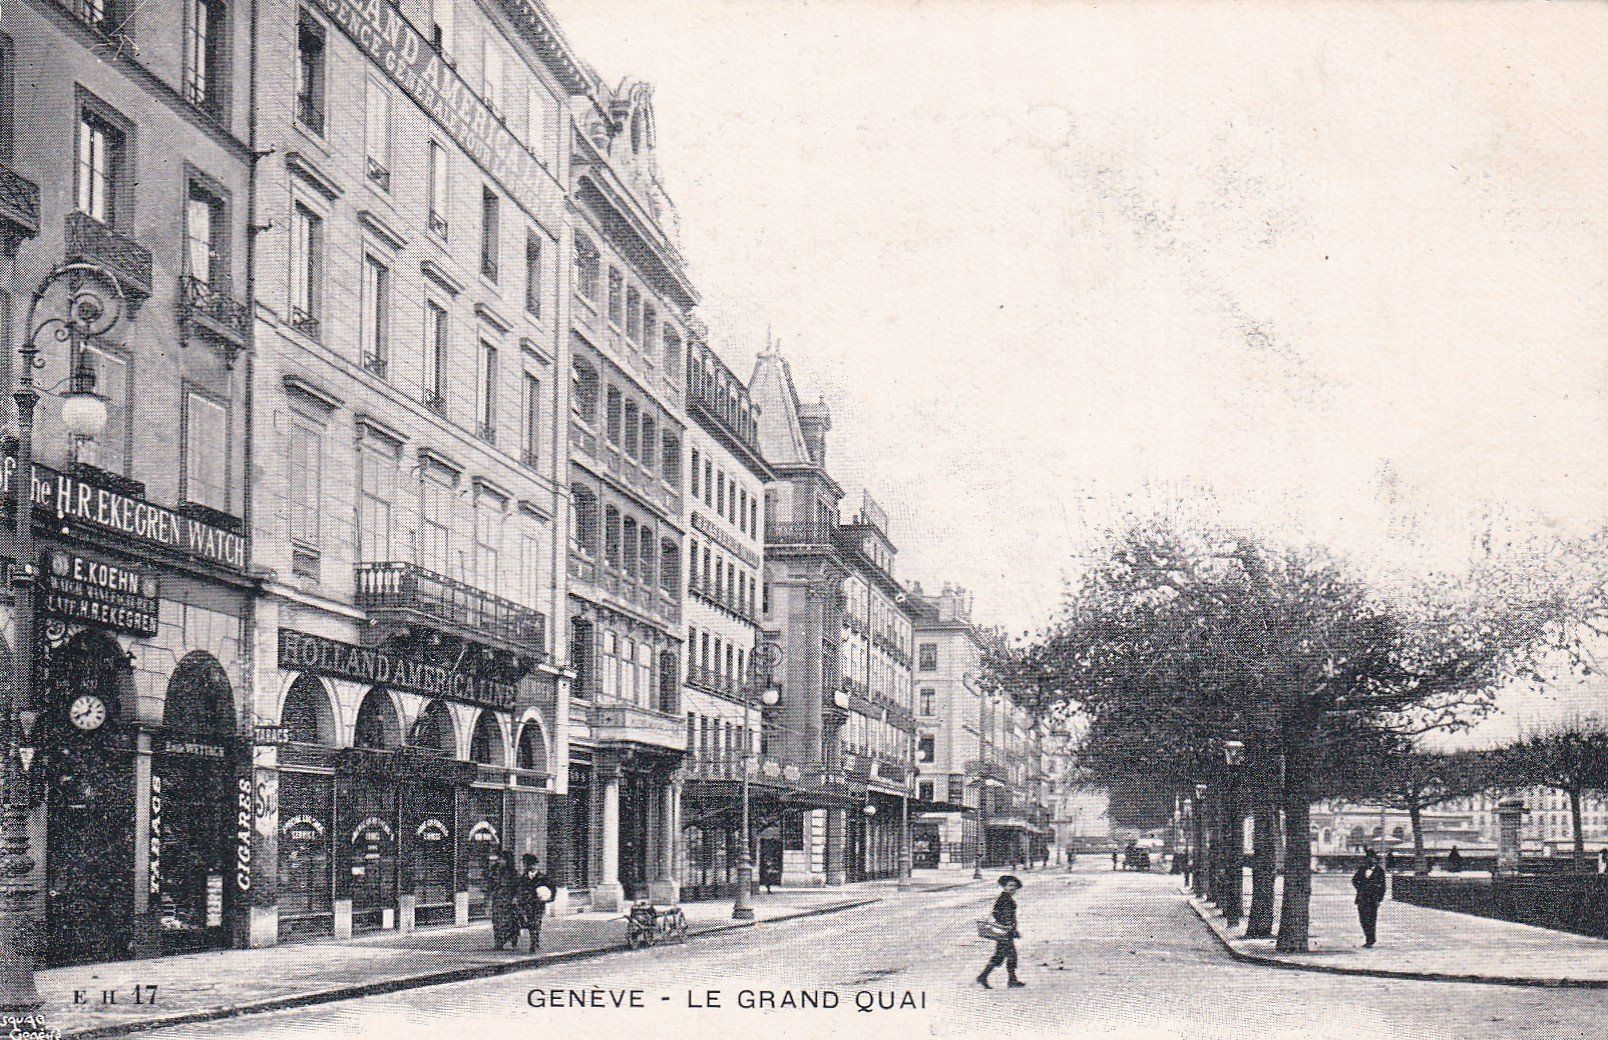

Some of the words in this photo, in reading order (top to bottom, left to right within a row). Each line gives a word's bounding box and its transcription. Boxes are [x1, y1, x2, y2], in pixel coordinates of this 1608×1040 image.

[422, 54, 517, 173] AMERICA
[56, 476, 181, 546] H.R.EKEGREN
[188, 522, 244, 567] WATCH
[74, 557, 139, 594] E.KOEHN
[281, 630, 390, 682] HOLLAND
[393, 661, 475, 699] AMERICA
[479, 679, 517, 707] LINE
[150, 775, 161, 894] TABACS
[237, 778, 251, 891] CIGARES
